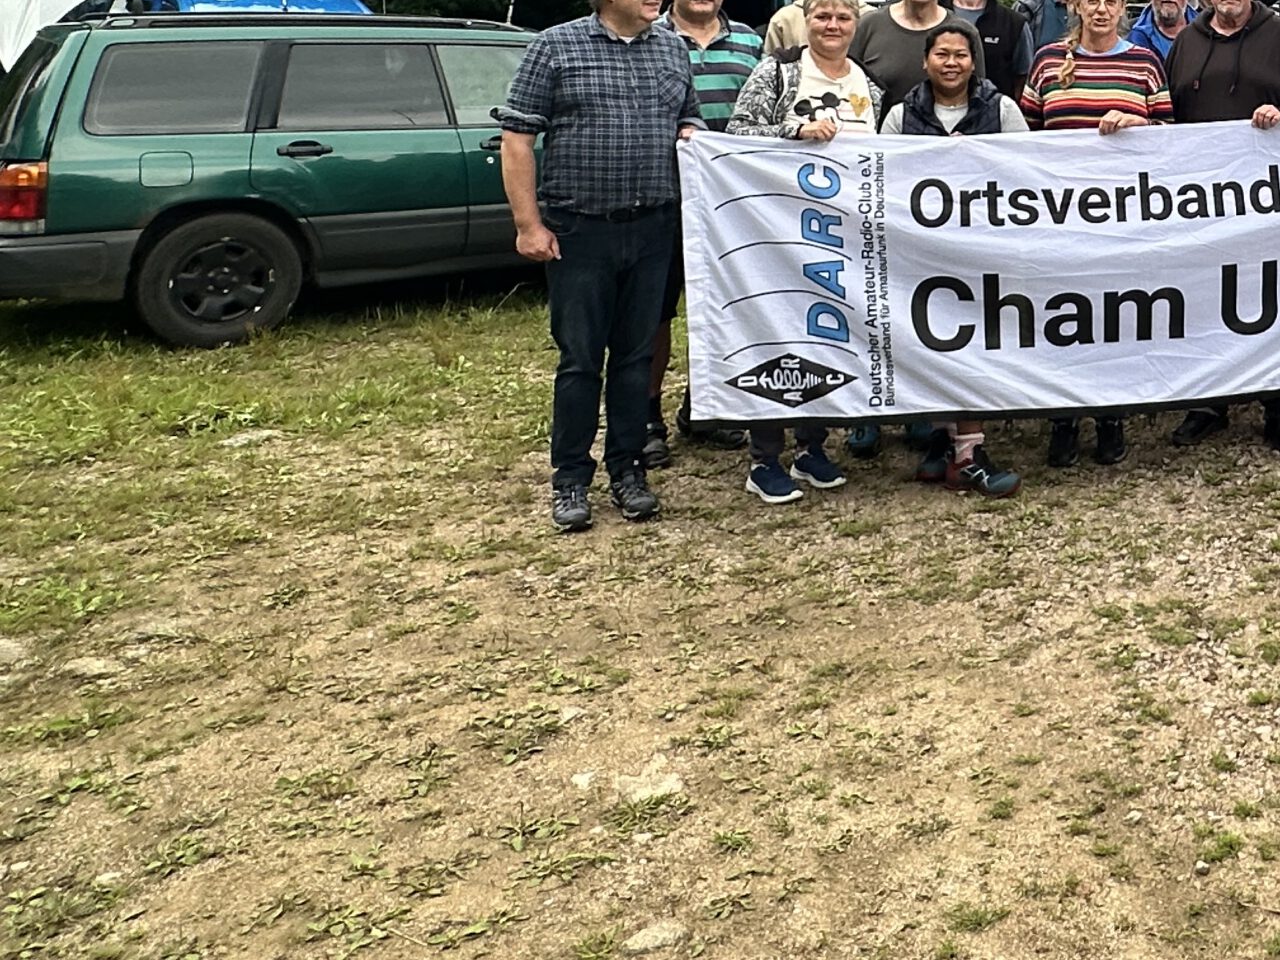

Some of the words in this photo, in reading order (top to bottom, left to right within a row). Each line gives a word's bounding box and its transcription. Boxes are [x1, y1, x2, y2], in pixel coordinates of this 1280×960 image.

[874, 152, 885, 218] Deutschland
[797, 163, 850, 343] DARC
[858, 182, 879, 329] Amateur-Radio-Club
[875, 222, 885, 232] in
[875, 234, 889, 301] Amateurfunk
[881, 303, 891, 319] für
[911, 273, 1185, 353] Cham
[867, 332, 883, 407] Deutscher
[881, 322, 896, 407] Bundesverband
